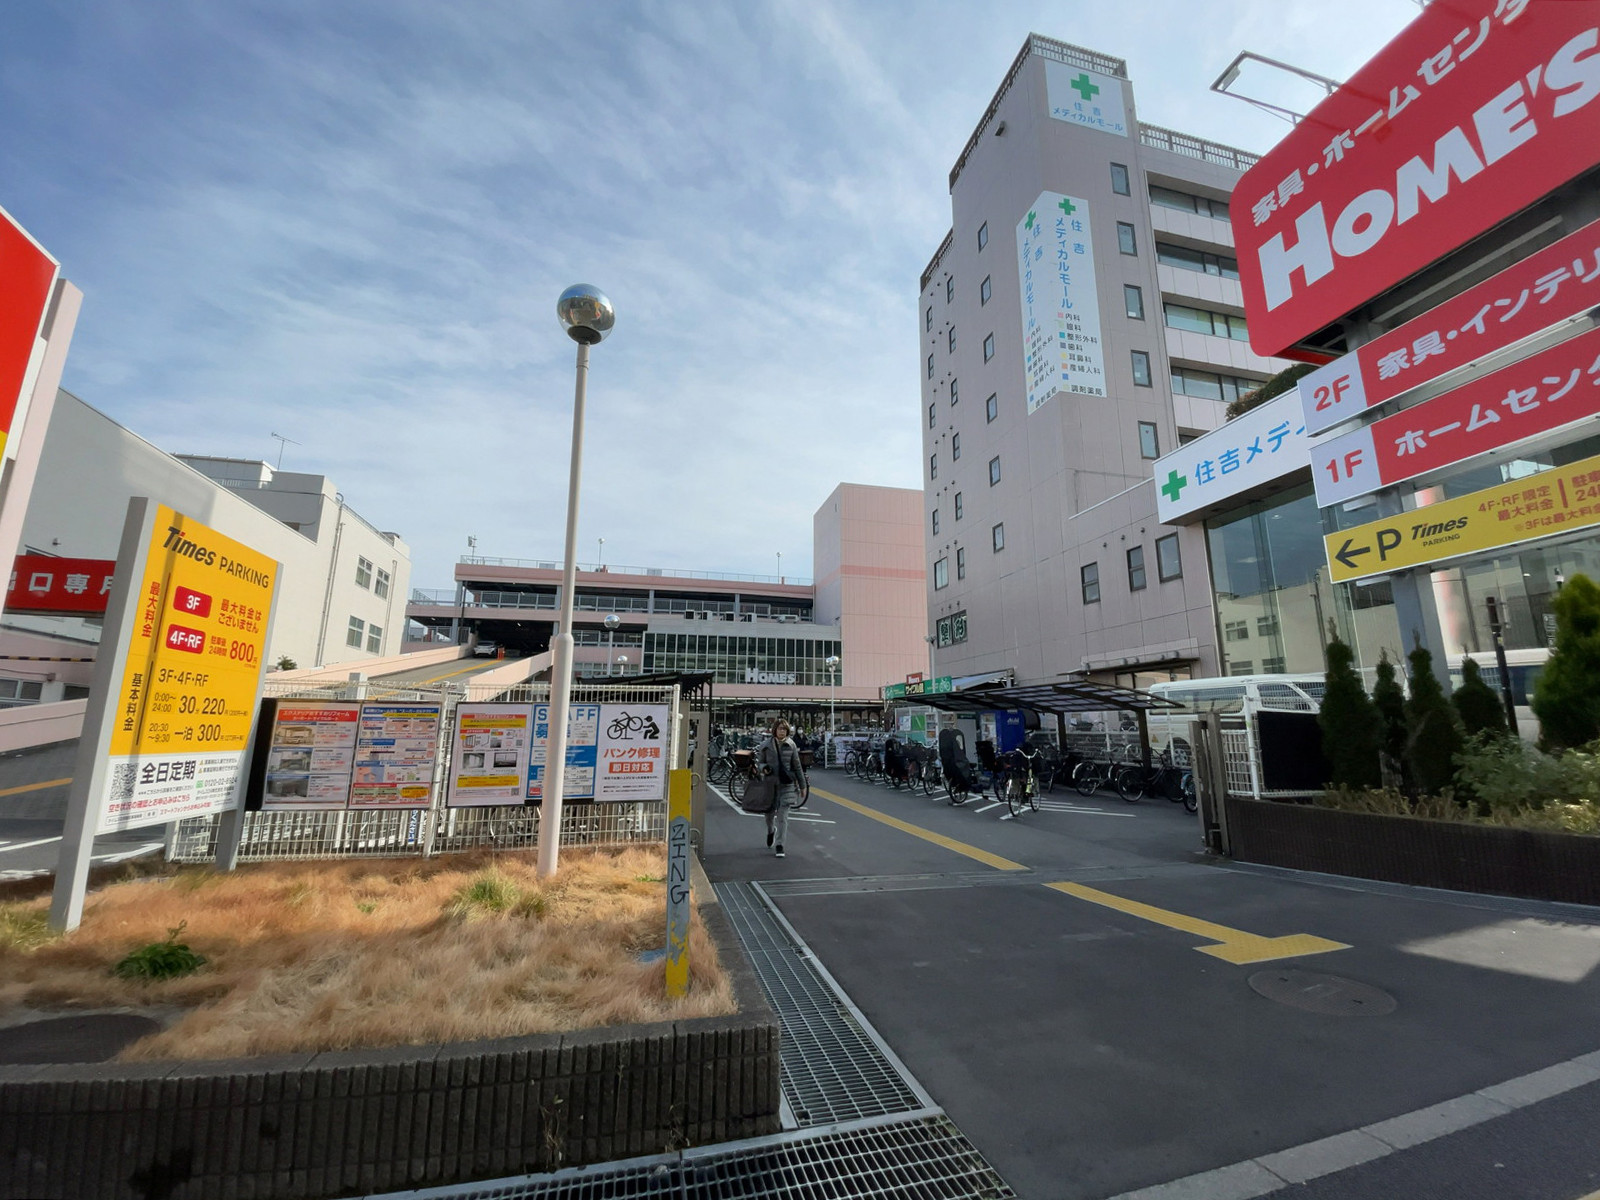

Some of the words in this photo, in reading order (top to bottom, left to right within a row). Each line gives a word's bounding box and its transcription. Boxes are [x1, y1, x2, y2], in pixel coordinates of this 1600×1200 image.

[1053, 107, 1123, 131] メディカルモール
[1258, 27, 1600, 313] HOME'S
[1055, 217, 1073, 309] メディカルモール
[1065, 313, 1080, 321] 内科
[1067, 332, 1098, 344] 整形外科
[1068, 343, 1083, 351] 歯科
[1069, 364, 1101, 375] 産婦人科
[1313, 374, 1351, 411] 2F
[1326, 448, 1363, 484] 1F
[1497, 498, 1554, 521] 最大料金
[1411, 515, 1468, 540] Times
[1376, 528, 1402, 562] P
[1422, 533, 1461, 547] PARKING
[163, 526, 217, 566] Times
[219, 556, 269, 589] PARKING
[142, 581, 161, 638] 最大料金
[186, 594, 201, 610] 3F
[220, 598, 262, 622] 最大料金は
[218, 612, 259, 634] ございません
[123, 673, 143, 731] 基本料金
[149, 723, 169, 732] 20:30
[174, 726, 193, 741] 一泊
[140, 760, 196, 784] 全日定期
[670, 823, 690, 905] ZING
